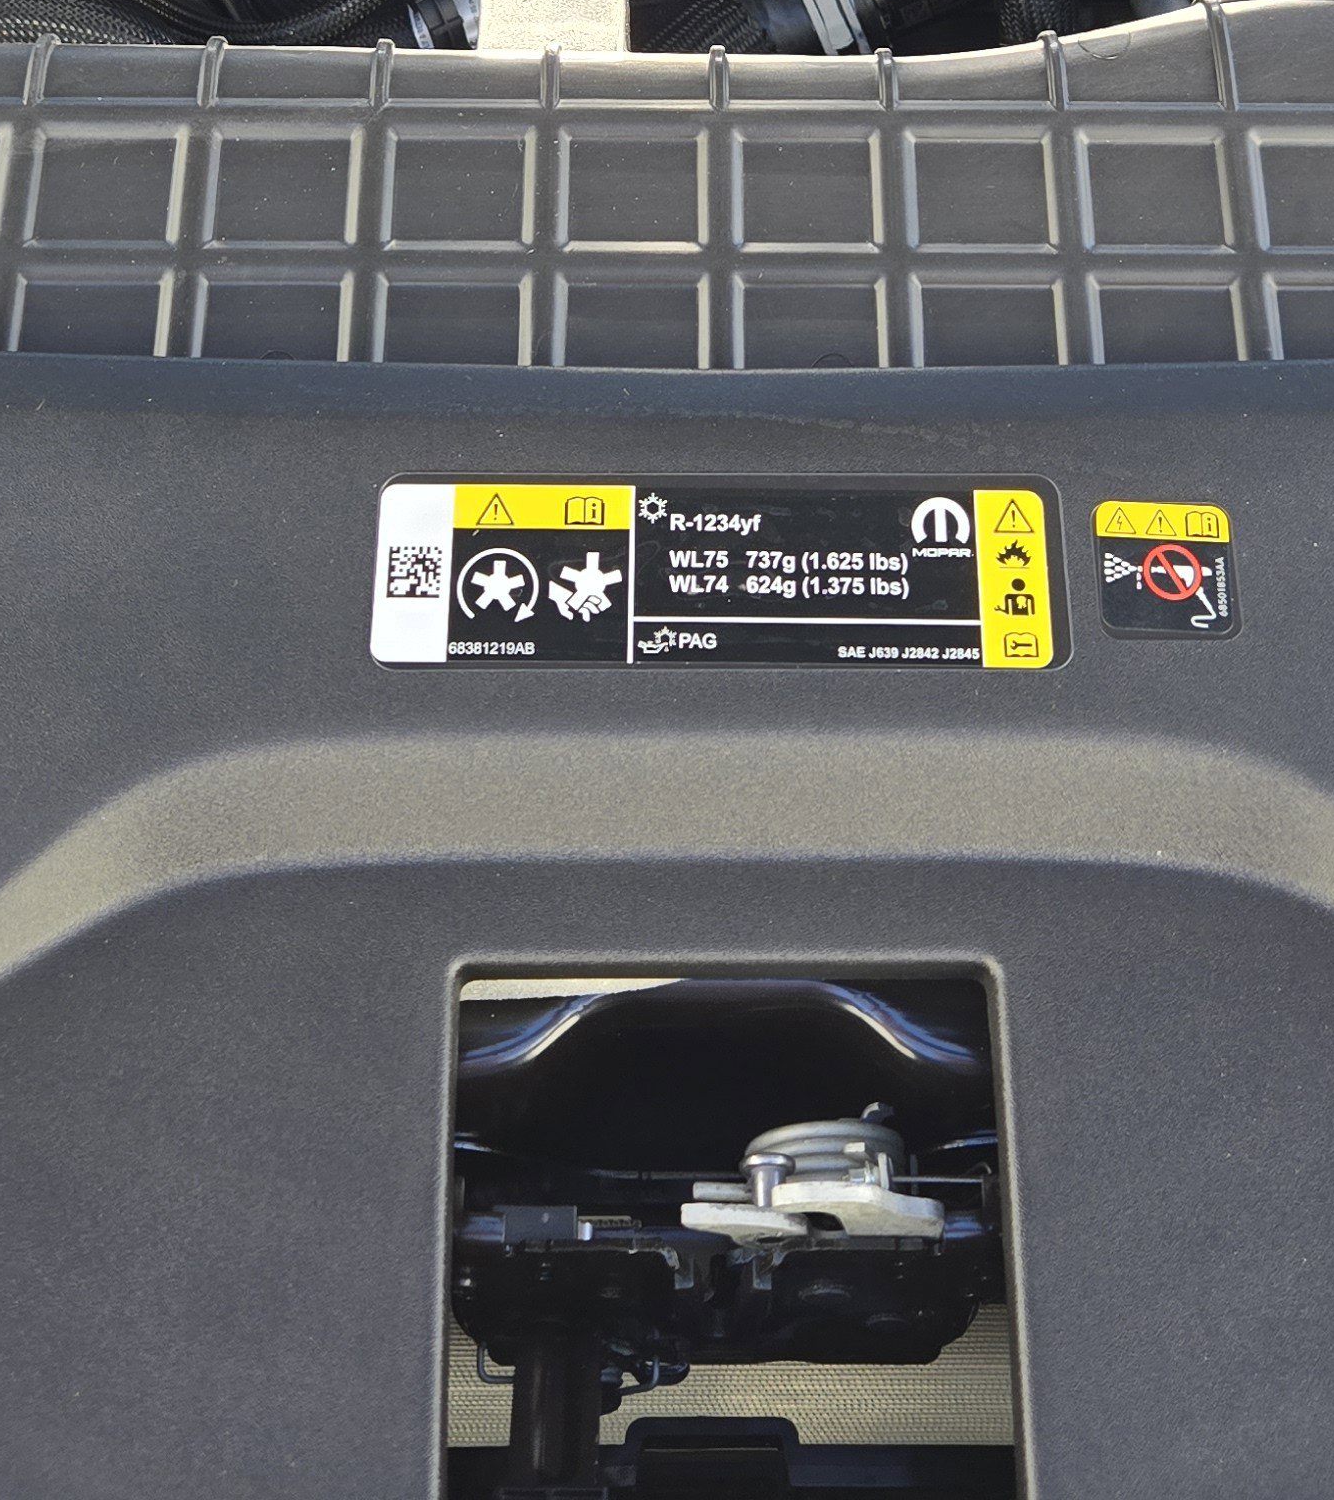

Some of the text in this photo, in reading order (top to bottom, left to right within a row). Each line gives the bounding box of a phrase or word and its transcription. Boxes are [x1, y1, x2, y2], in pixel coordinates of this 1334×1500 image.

[669, 513, 761, 536] R-1234yf
[912, 547, 972, 558] MOPAR
[669, 549, 909, 575] WL75 737g (1.625 lbs)
[669, 574, 910, 600] WL74 624g (1.375 lbs)
[448, 641, 536, 655] 68381219AB
[678, 632, 717, 649] PAG
[837, 646, 980, 660] SAE J639 J2842 J2845
